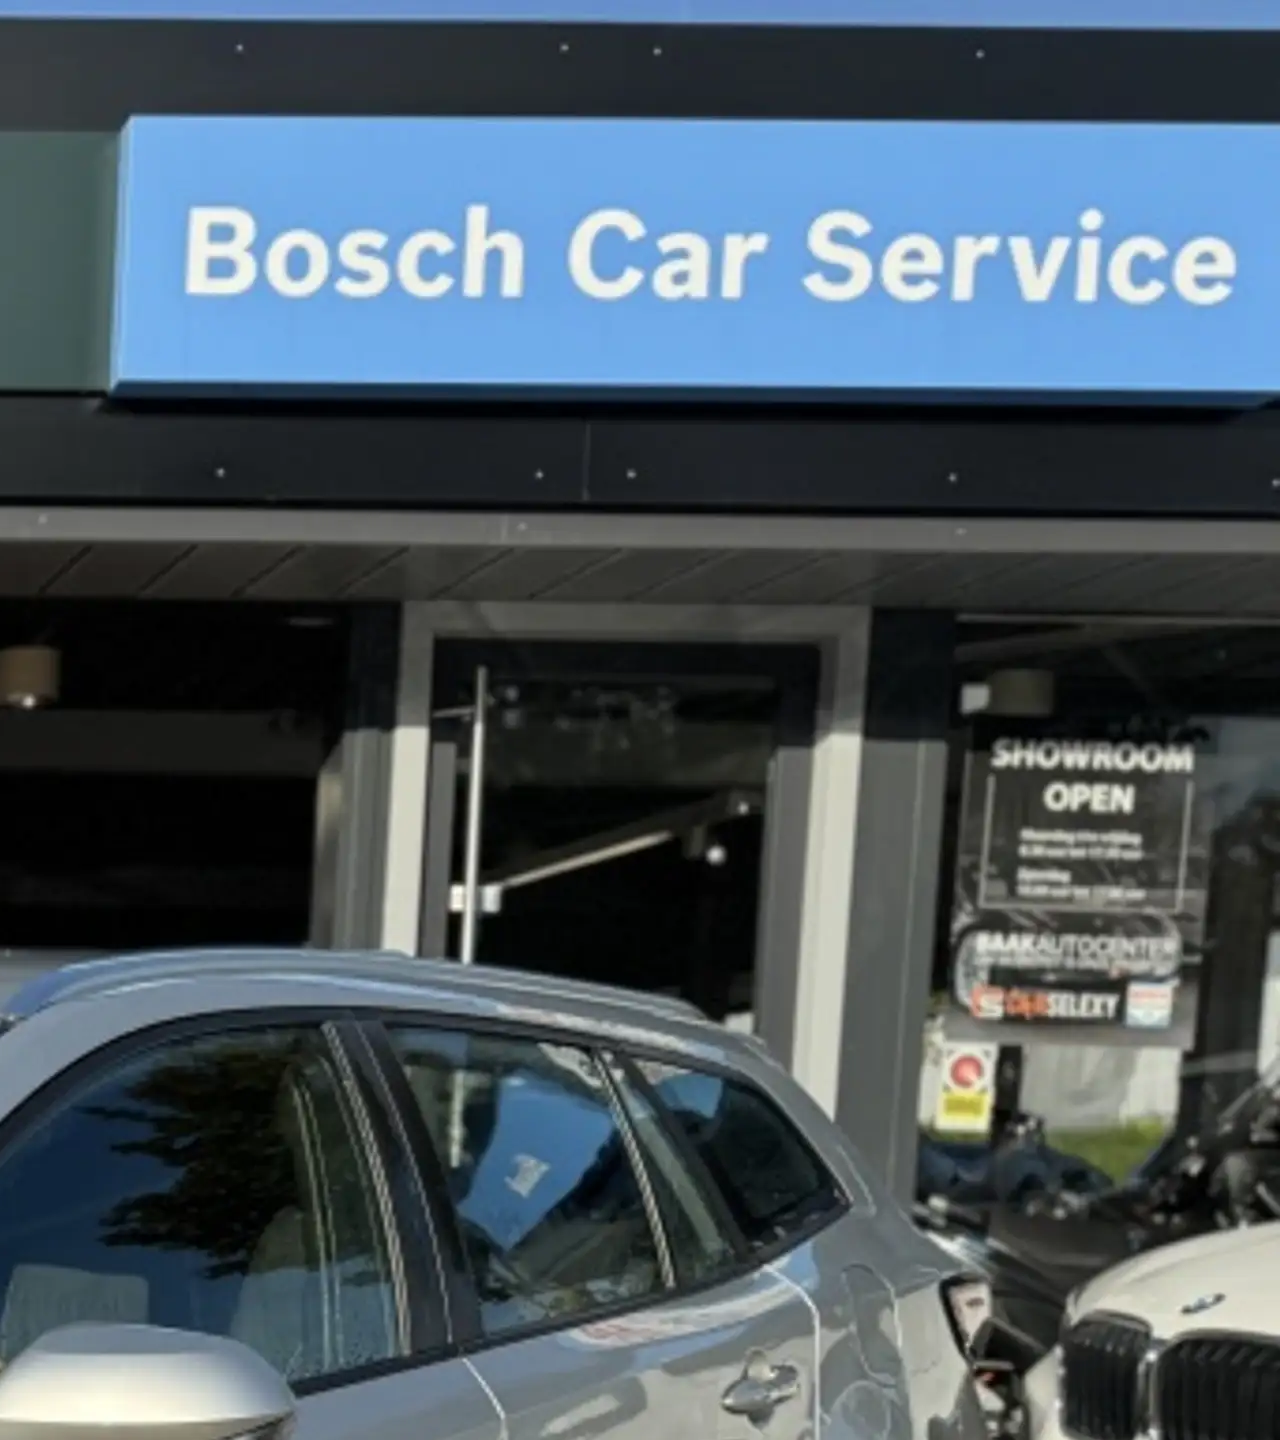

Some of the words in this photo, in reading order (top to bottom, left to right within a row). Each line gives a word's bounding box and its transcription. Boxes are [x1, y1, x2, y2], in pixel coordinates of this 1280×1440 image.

[184, 204, 525, 299] Bosch
[566, 208, 768, 300] Car
[801, 208, 1237, 305] Service
[991, 737, 1195, 774] SHOWROOM
[1043, 781, 1136, 815] OPEN
